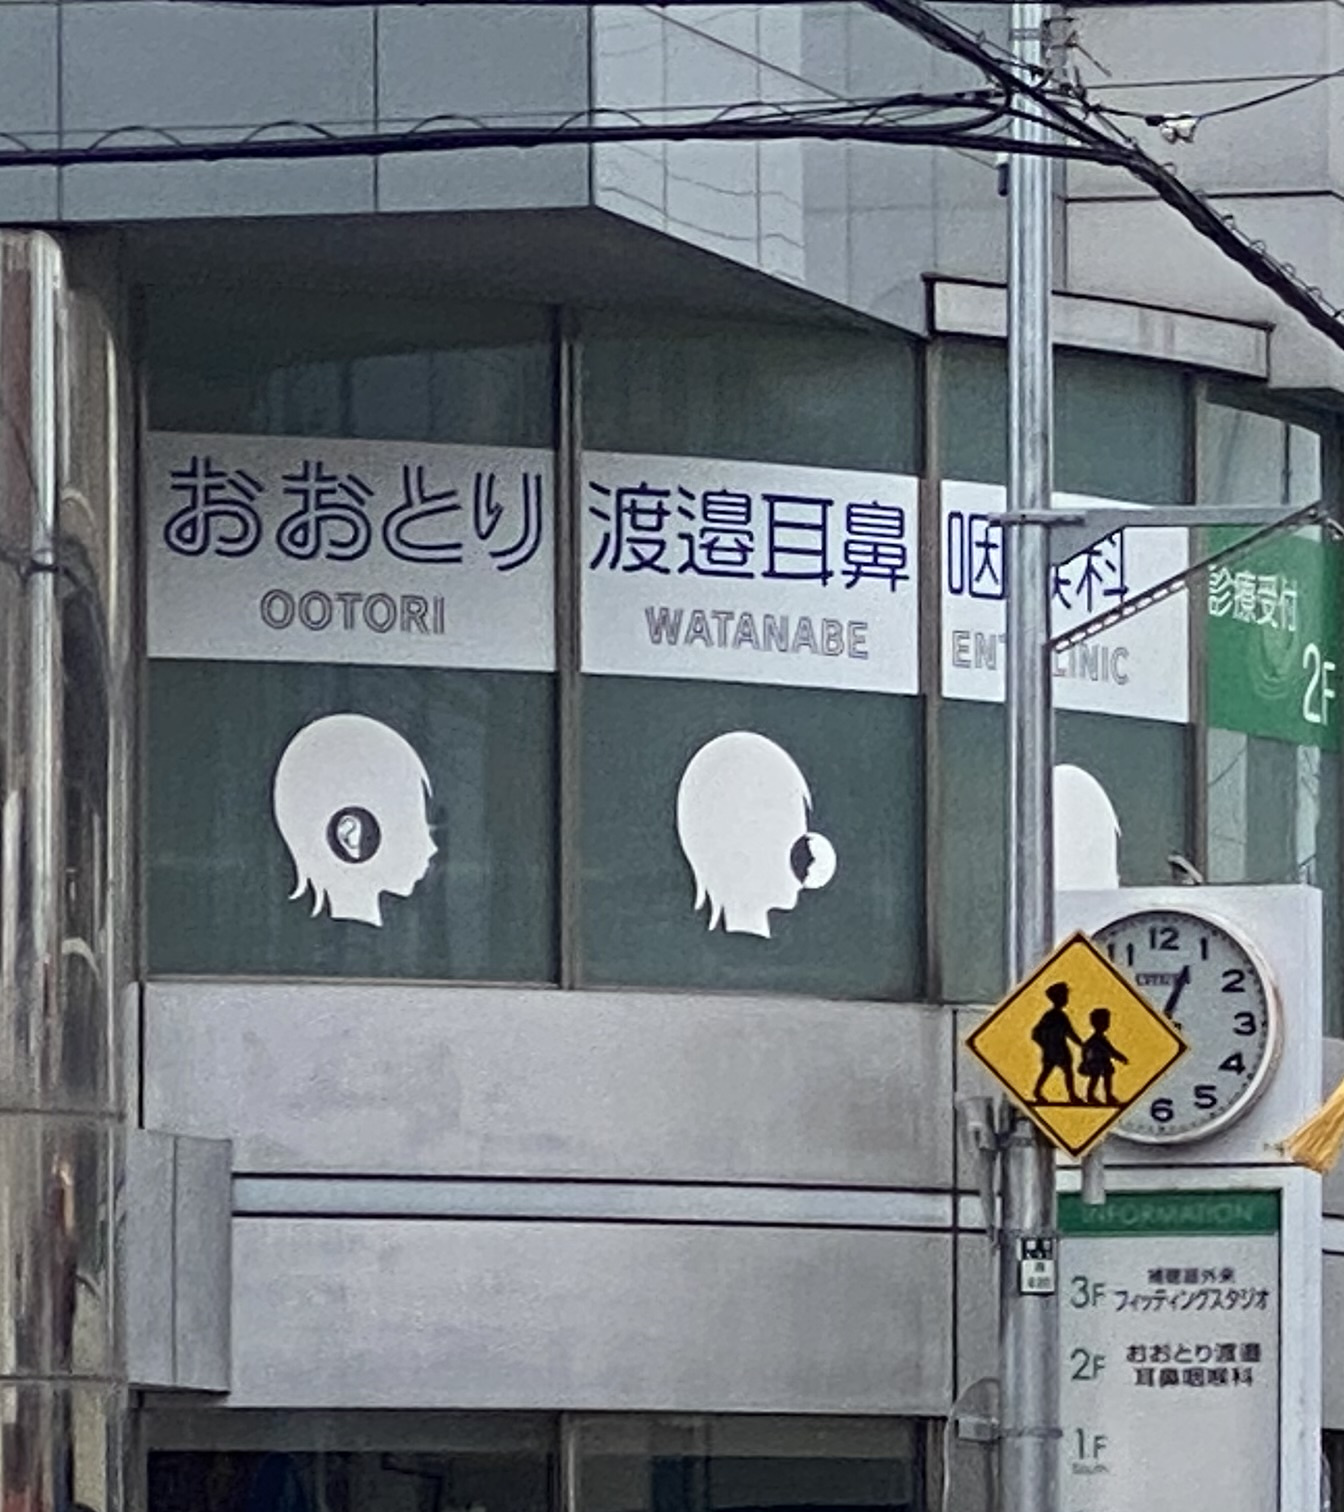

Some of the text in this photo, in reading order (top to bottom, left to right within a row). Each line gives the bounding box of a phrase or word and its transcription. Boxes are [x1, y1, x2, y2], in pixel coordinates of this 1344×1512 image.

[163, 456, 543, 571] おおとり
[947, 511, 1129, 612] 咽科
[1208, 564, 1297, 632] 診療受付
[260, 589, 444, 634] OOTORI
[645, 606, 869, 659] WATANABE
[952, 629, 1006, 670] EN
[1302, 642, 1336, 726] 2F
[1149, 926, 1181, 951] 12
[1199, 936, 1209, 961] 1
[1222, 969, 1246, 993] 2
[1233, 1012, 1257, 1036] 3
[1219, 1053, 1246, 1075] 4
[1150, 1098, 1174, 1123] 6
[1193, 1085, 1218, 1110] 5
[1071, 1275, 1106, 1309] 3F
[1071, 1348, 1107, 1381] 2F
[1076, 1427, 1108, 1460] 1F
